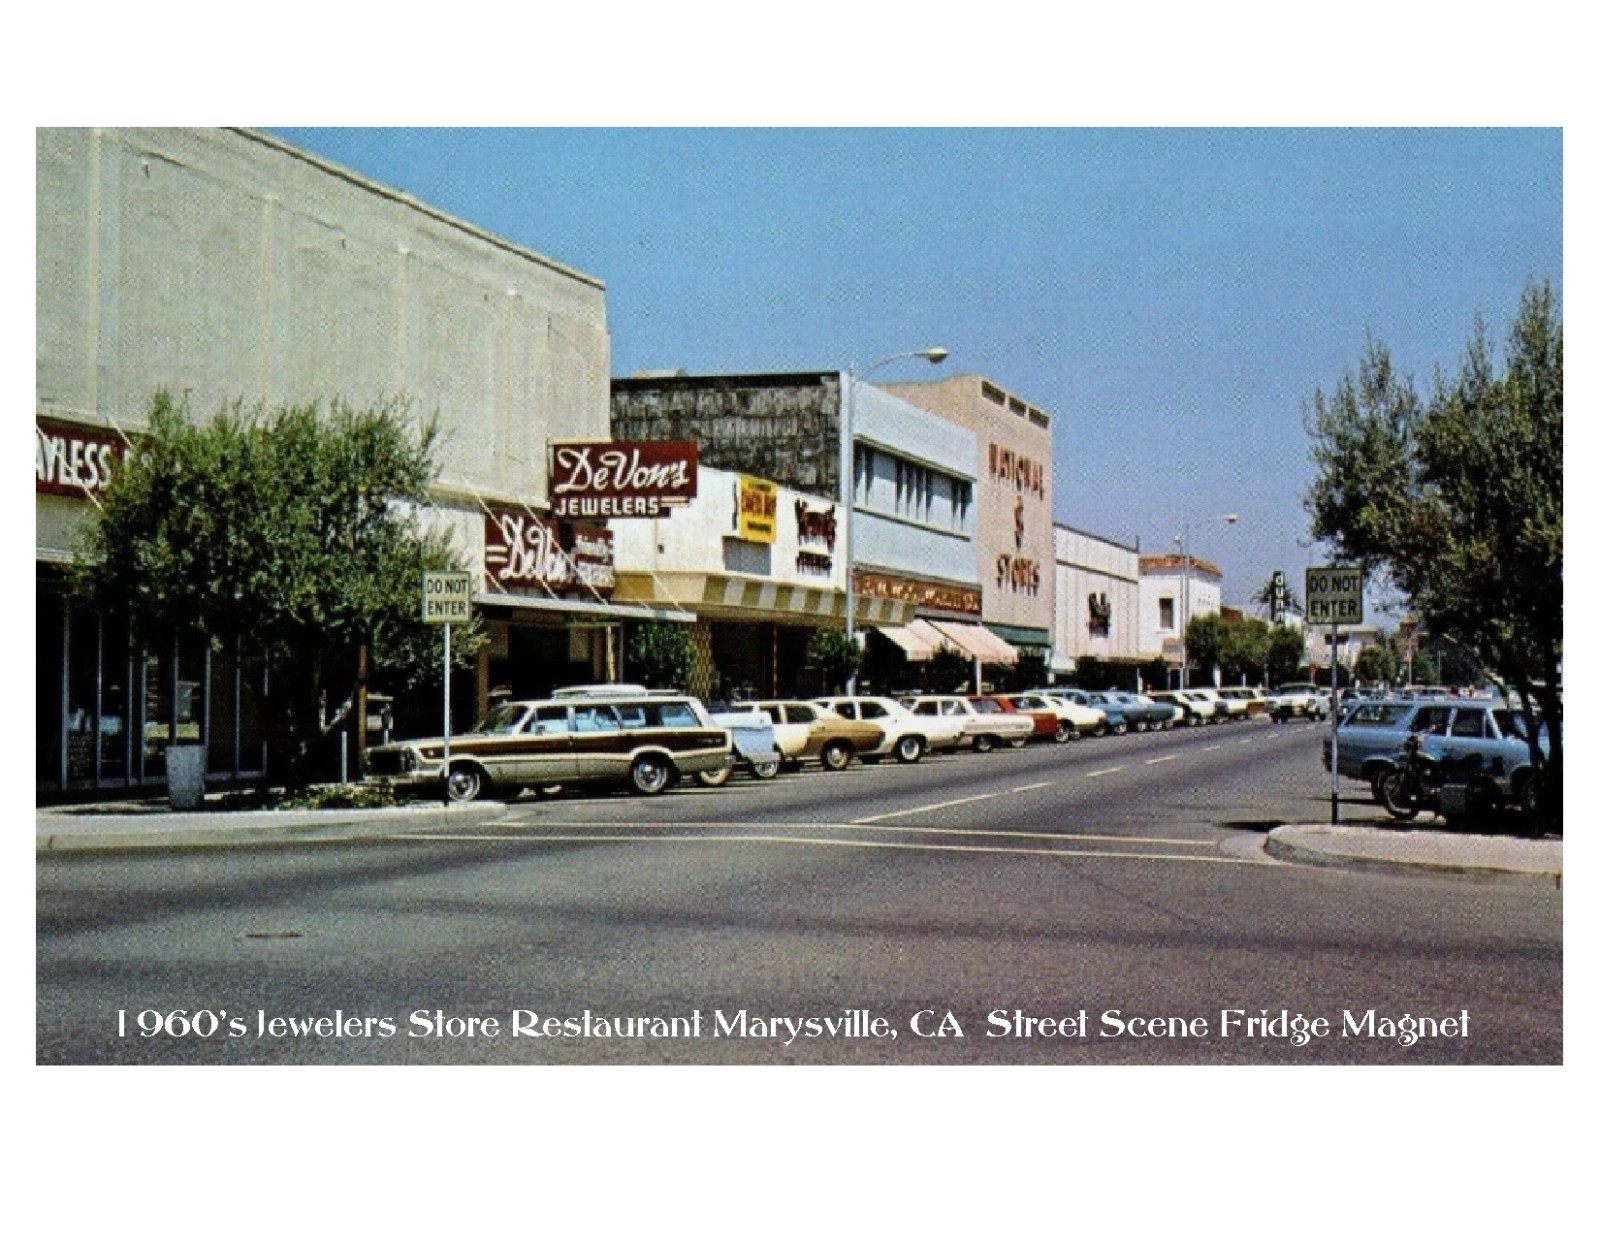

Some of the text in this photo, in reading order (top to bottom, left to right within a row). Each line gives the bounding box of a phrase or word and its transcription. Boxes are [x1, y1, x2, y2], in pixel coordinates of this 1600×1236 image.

[554, 448, 690, 494] DeVon's
[555, 497, 660, 516] JEWELERS
[427, 579, 468, 594] DO NOT
[1310, 575, 1359, 592] DO NOT
[427, 600, 467, 616] ENTER
[1310, 599, 1357, 617] ENTER
